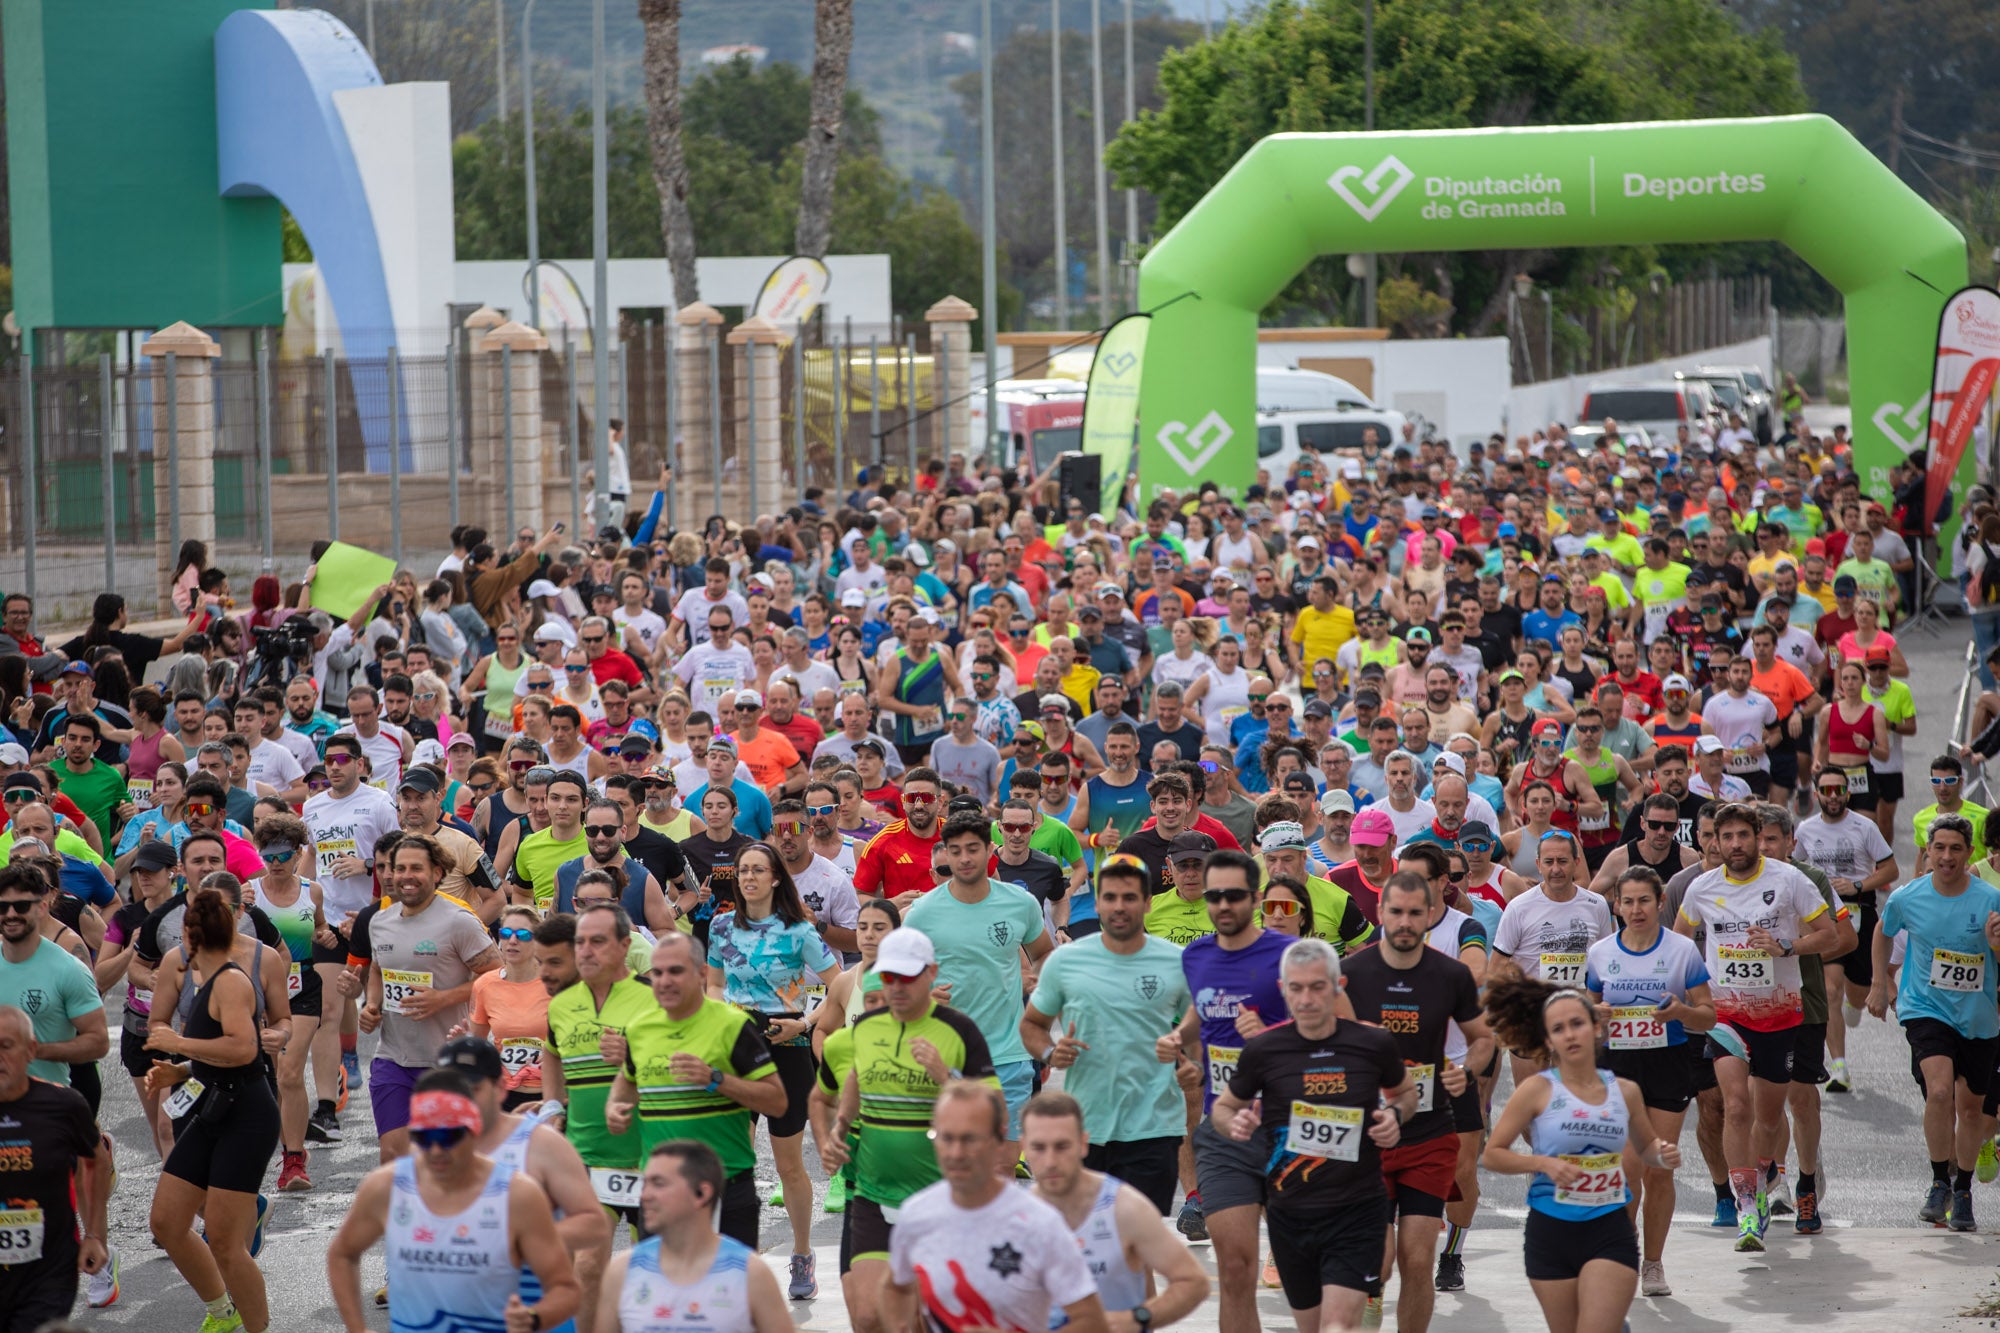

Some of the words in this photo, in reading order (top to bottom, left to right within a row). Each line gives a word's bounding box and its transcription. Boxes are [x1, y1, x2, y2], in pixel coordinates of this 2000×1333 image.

[1424, 173, 1562, 198] Diputación
[1622, 170, 1766, 200] Deportes
[1421, 200, 1452, 220] de
[1458, 197, 1567, 219] Granada
[1547, 966, 1580, 980] 217
[1725, 962, 1764, 978] 433
[1941, 963, 1978, 982] 780
[1611, 982, 1667, 991] MARACENA
[1205, 1006, 1238, 1018] WORLD
[1382, 1011, 1419, 1020] FONDO
[1609, 1021, 1664, 1038] 2128
[1303, 1072, 1346, 1082] FONDO
[1304, 1081, 1348, 1096] 2025
[1300, 1121, 1351, 1145] 997
[1560, 1122, 1625, 1136] MARACENA
[608, 1174, 638, 1194] 67
